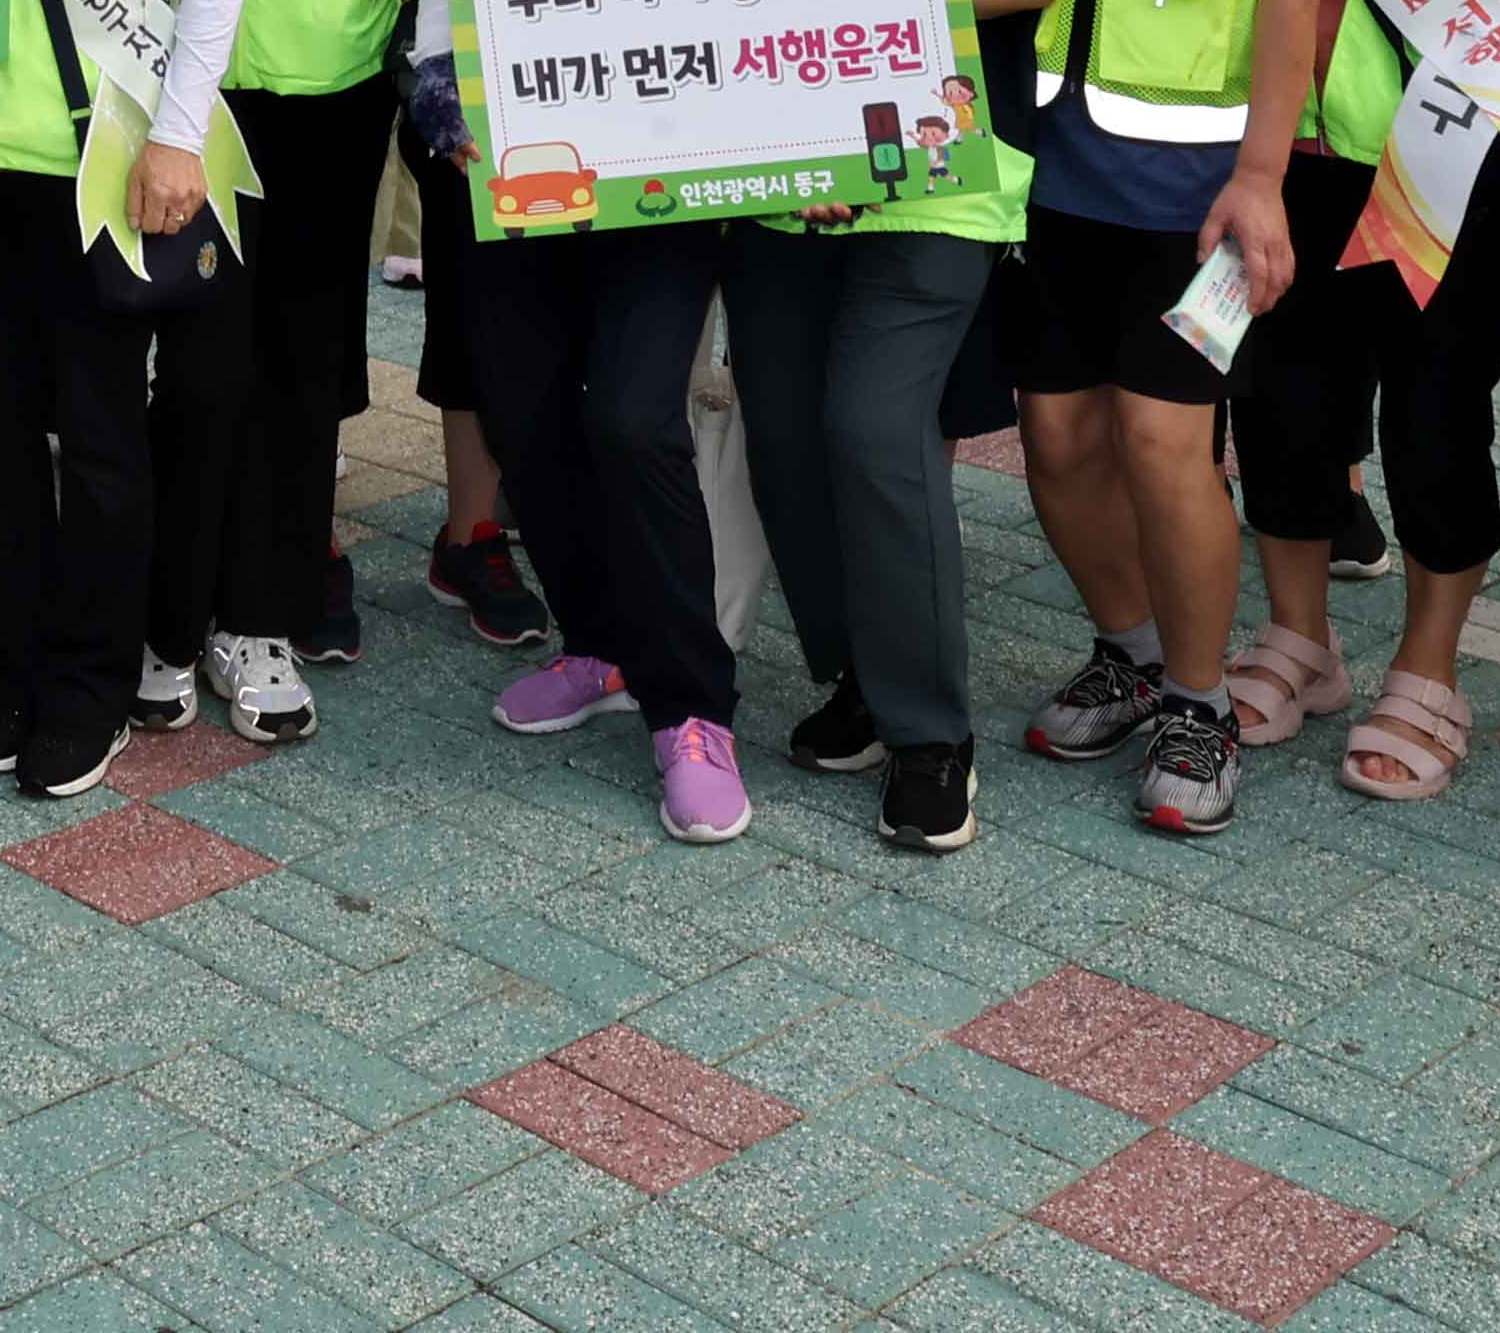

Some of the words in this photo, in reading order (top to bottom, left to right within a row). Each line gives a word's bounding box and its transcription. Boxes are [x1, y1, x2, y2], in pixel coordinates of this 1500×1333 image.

[512, 53, 610, 102] 내가
[624, 41, 718, 97] 먼저
[733, 19, 925, 85] 서행운전
[679, 177, 789, 208] 인천광역시
[793, 169, 835, 194] 동구
